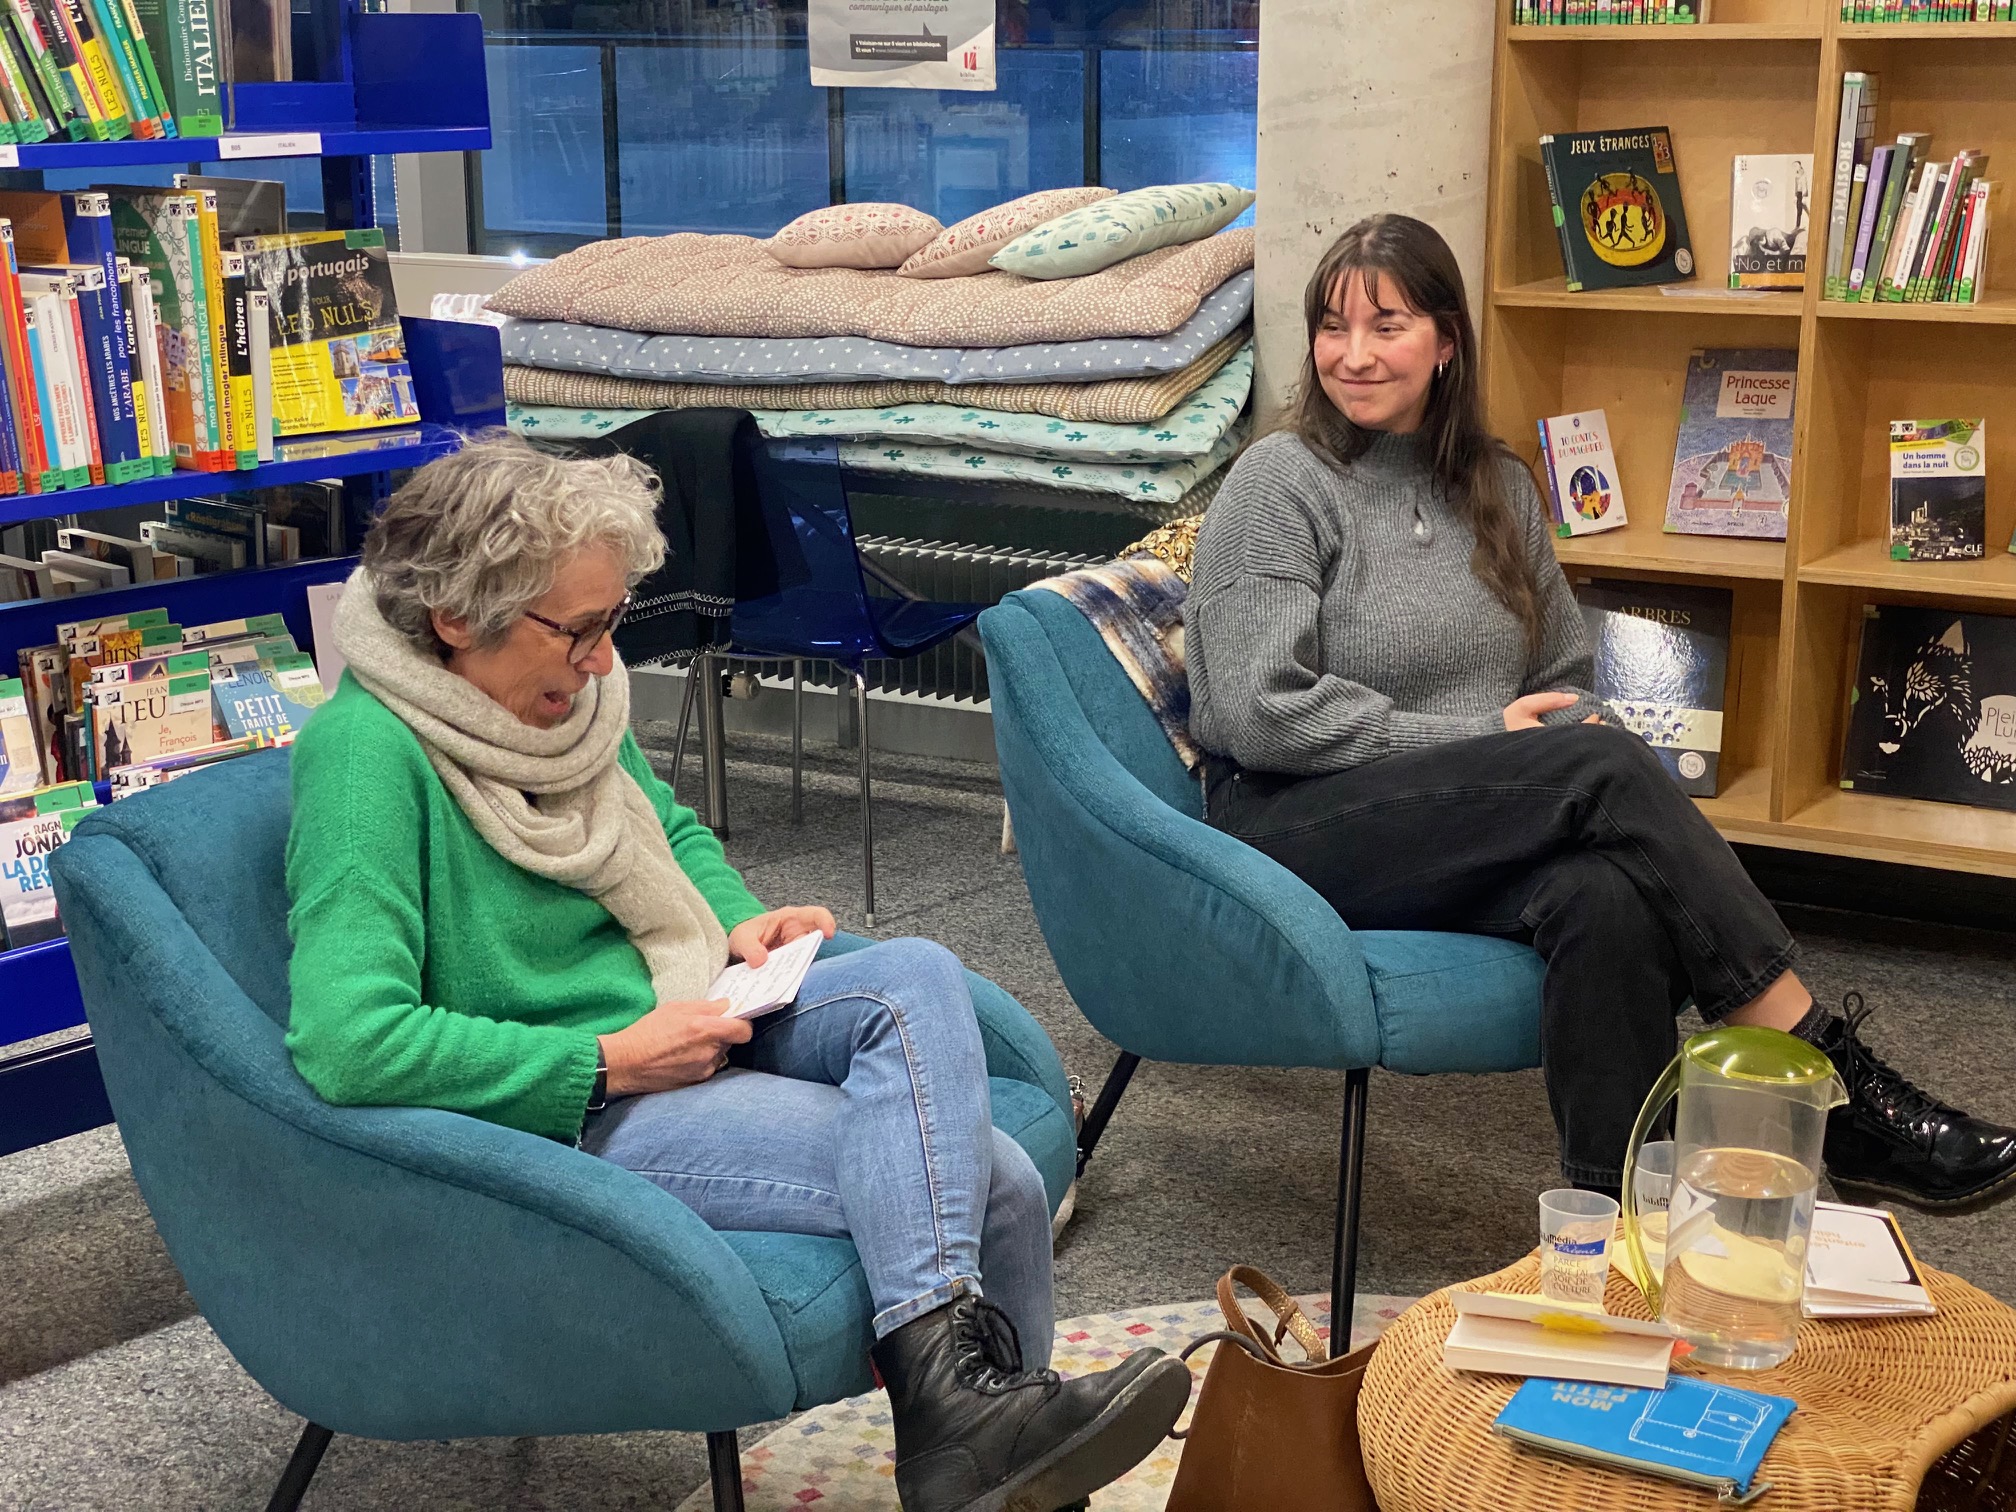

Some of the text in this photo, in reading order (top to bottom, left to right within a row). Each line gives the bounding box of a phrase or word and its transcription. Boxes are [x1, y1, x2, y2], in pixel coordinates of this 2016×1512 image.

[849, 3, 948, 14] communiquer et partager
[50, 9, 68, 44] L'italien
[178, 0, 193, 81] Dictionnaire Com
[189, 0, 216, 96] ITALIE
[122, 40, 139, 69] IMAGIER
[45, 57, 71, 109] Bescherelle
[90, 54, 119, 112] LES NULS
[132, 71, 148, 100] PREMIER
[1571, 135, 1650, 155] JEUX ÉTRANGES
[1834, 141, 1853, 210] MAISONS
[288, 254, 369, 286] portugais
[1738, 258, 1760, 271] No
[1766, 259, 1781, 271] et
[235, 298, 247, 356] L'hébreu
[275, 301, 375, 336] LES NULS
[105, 251, 134, 418] L'ARABE pour les francophones
[124, 309, 136, 354] L'arabe
[102, 335, 113, 360] ARABES
[218, 324, 227, 369] Trilingue
[106, 360, 114, 374] LES
[198, 301, 217, 428] mon premier TRILINGUE
[221, 370, 231, 409] Imagier
[1727, 375, 1790, 390] Princesse
[1735, 391, 1777, 406] Laque
[113, 408, 121, 421] NOS
[135, 393, 149, 449] LES NULS
[243, 388, 255, 444] LES NULS
[225, 412, 234, 440] Grand
[1561, 431, 1599, 446] 10 CONTES
[1568, 442, 1605, 456] MAGHREB
[1903, 452, 1946, 460] Un homme
[1903, 461, 1921, 469] dans
[1964, 543, 1983, 553] CLE
[1619, 606, 1691, 625] ARBRES
[146, 685, 168, 696] JEAN
[120, 696, 190, 724] TEU
[234, 694, 284, 719] PETIT
[1986, 707, 2016, 726] Plei
[158, 724, 171, 735] Je,
[241, 713, 290, 731] TRAITÉ DE
[160, 732, 197, 747] François
[33, 821, 62, 835] RAGN
[2, 859, 27, 879] LA
[19, 872, 53, 893] REY
[1553, 1256, 1580, 1268] PARCE
[1553, 1266, 1572, 1275] QUE
[1553, 1284, 1592, 1294] CULTURE
[1552, 1392, 1613, 1412] MON
